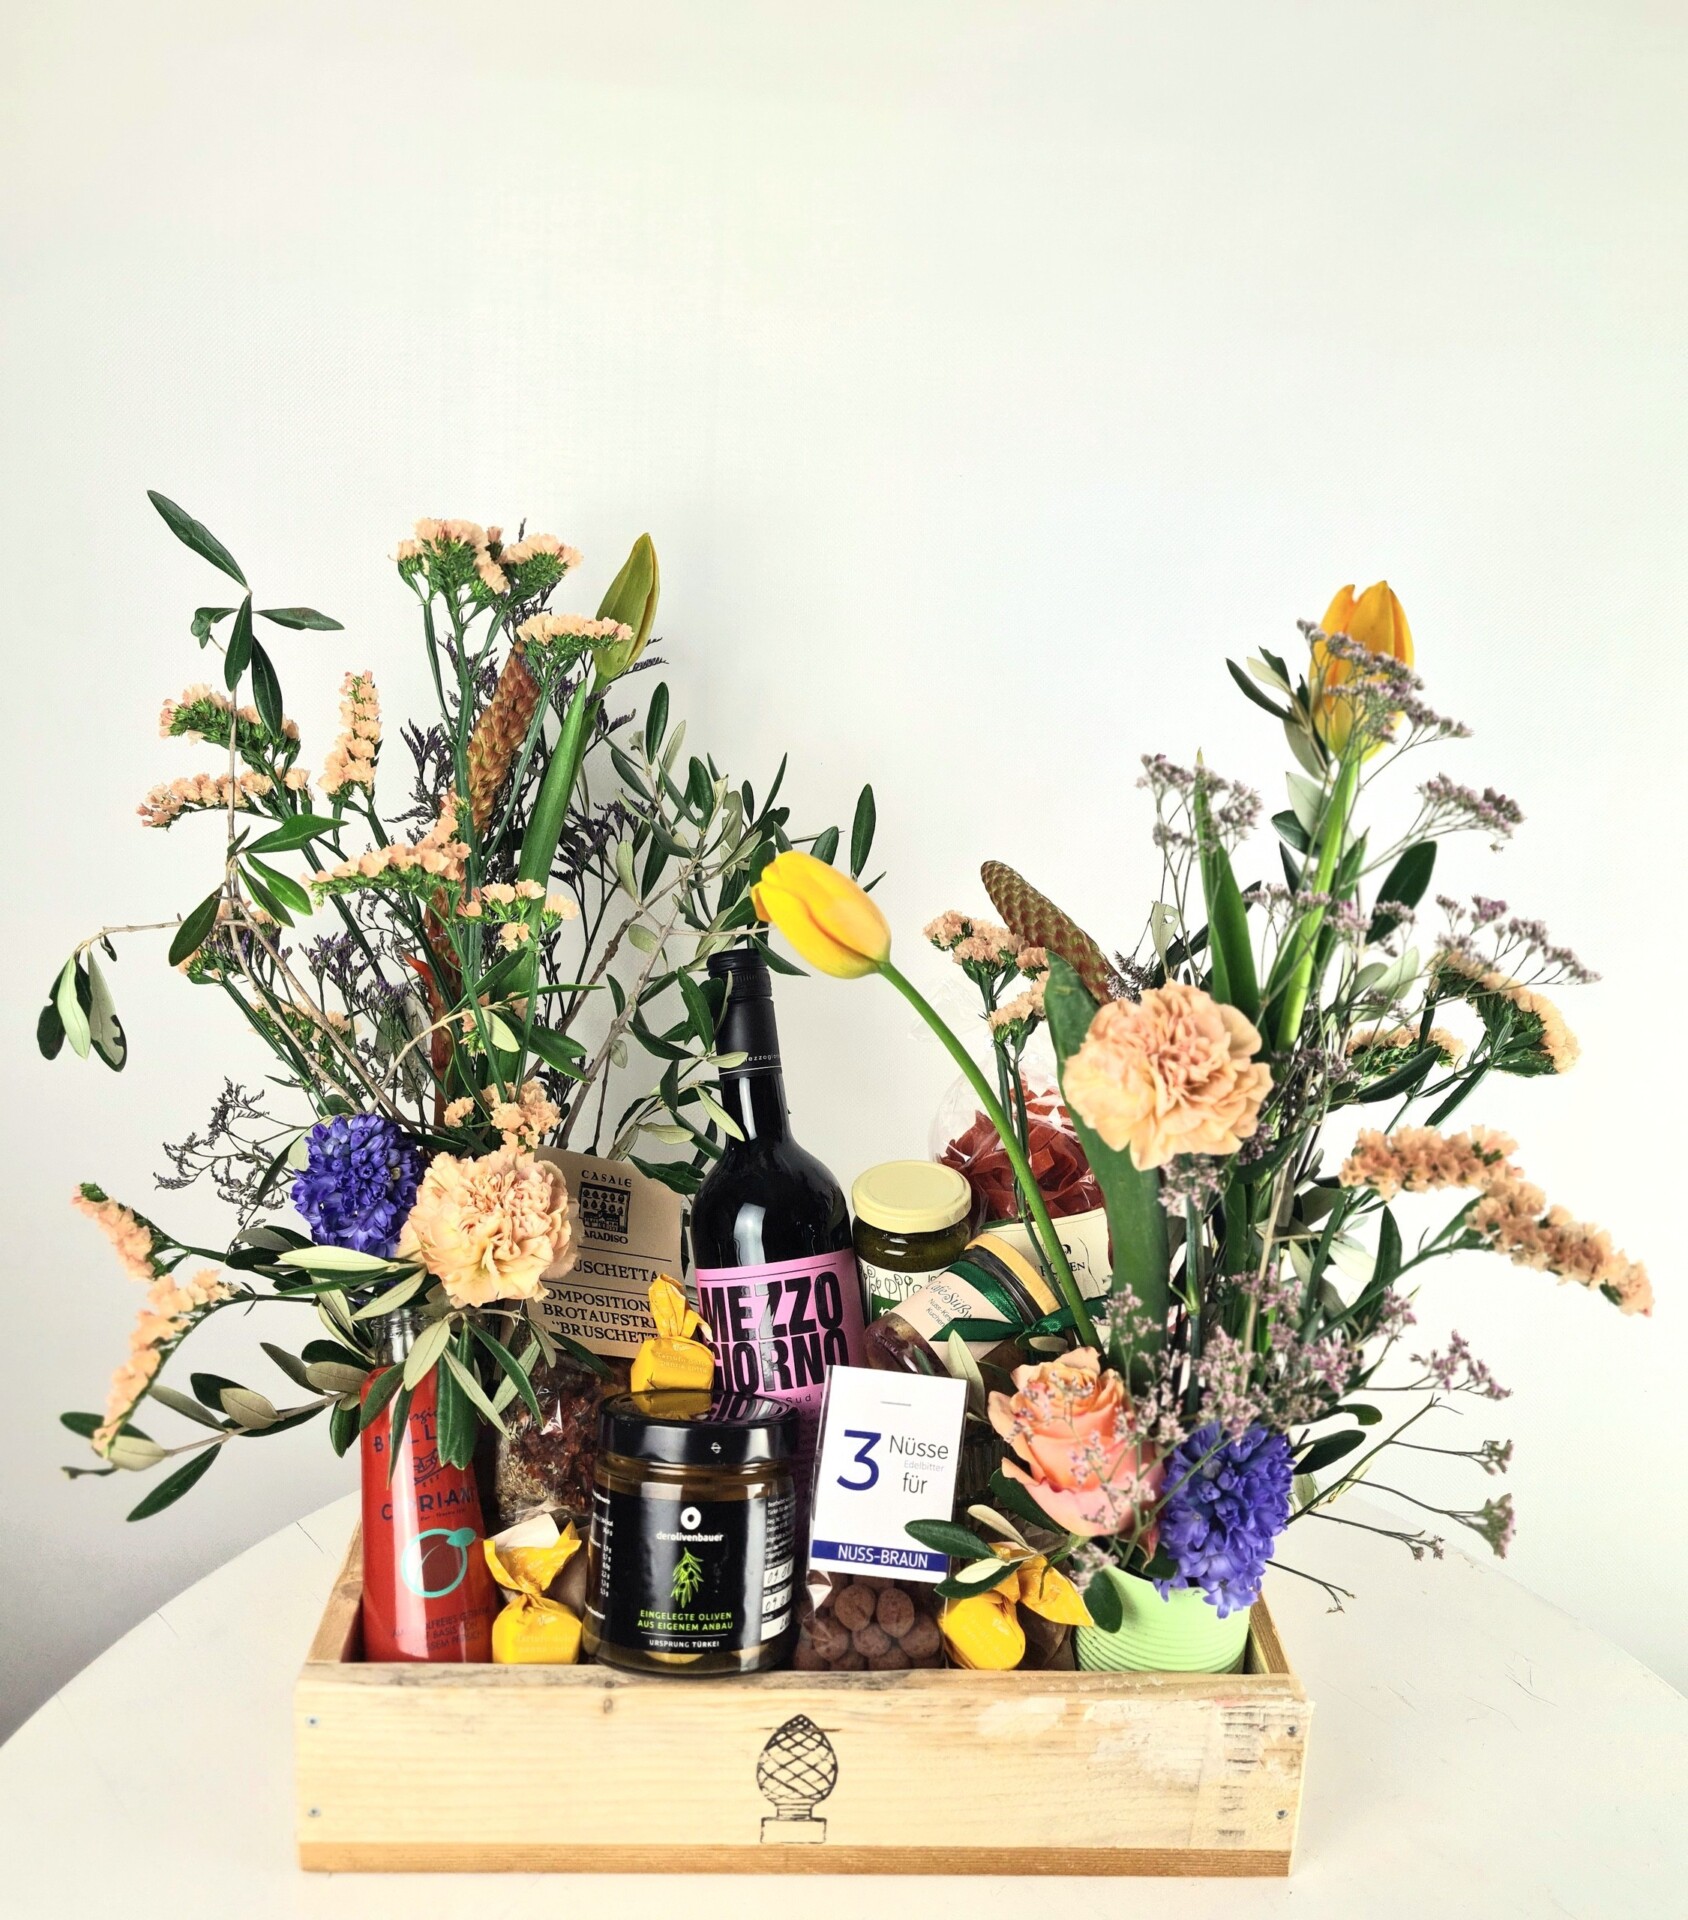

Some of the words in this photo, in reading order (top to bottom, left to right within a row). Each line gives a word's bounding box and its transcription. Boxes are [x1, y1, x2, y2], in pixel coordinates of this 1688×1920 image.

[581, 1169, 632, 1188] CASALE
[584, 1229, 629, 1245] ARADISO
[573, 1259, 659, 1283] USCHETTA
[546, 1287, 651, 1313] OMPOSITION
[700, 1271, 843, 1343] MEZZO
[837, 1429, 882, 1491] 3
[889, 1435, 949, 1460] Nüsse
[903, 1459, 945, 1472] Edelbitter
[903, 1472, 928, 1495] für
[656, 1531, 724, 1542] derolivenbauer
[837, 1544, 929, 1569] NUSS-BRAUN
[640, 1609, 695, 1621] EINGELEGTE
[698, 1611, 732, 1621] OLIVEN
[637, 1619, 655, 1629] AUS
[657, 1621, 699, 1631] EIGENEM
[702, 1622, 733, 1631] ANBAU
[649, 1639, 690, 1648] URSPRUNG
[692, 1640, 720, 1648] TÜRKEI
